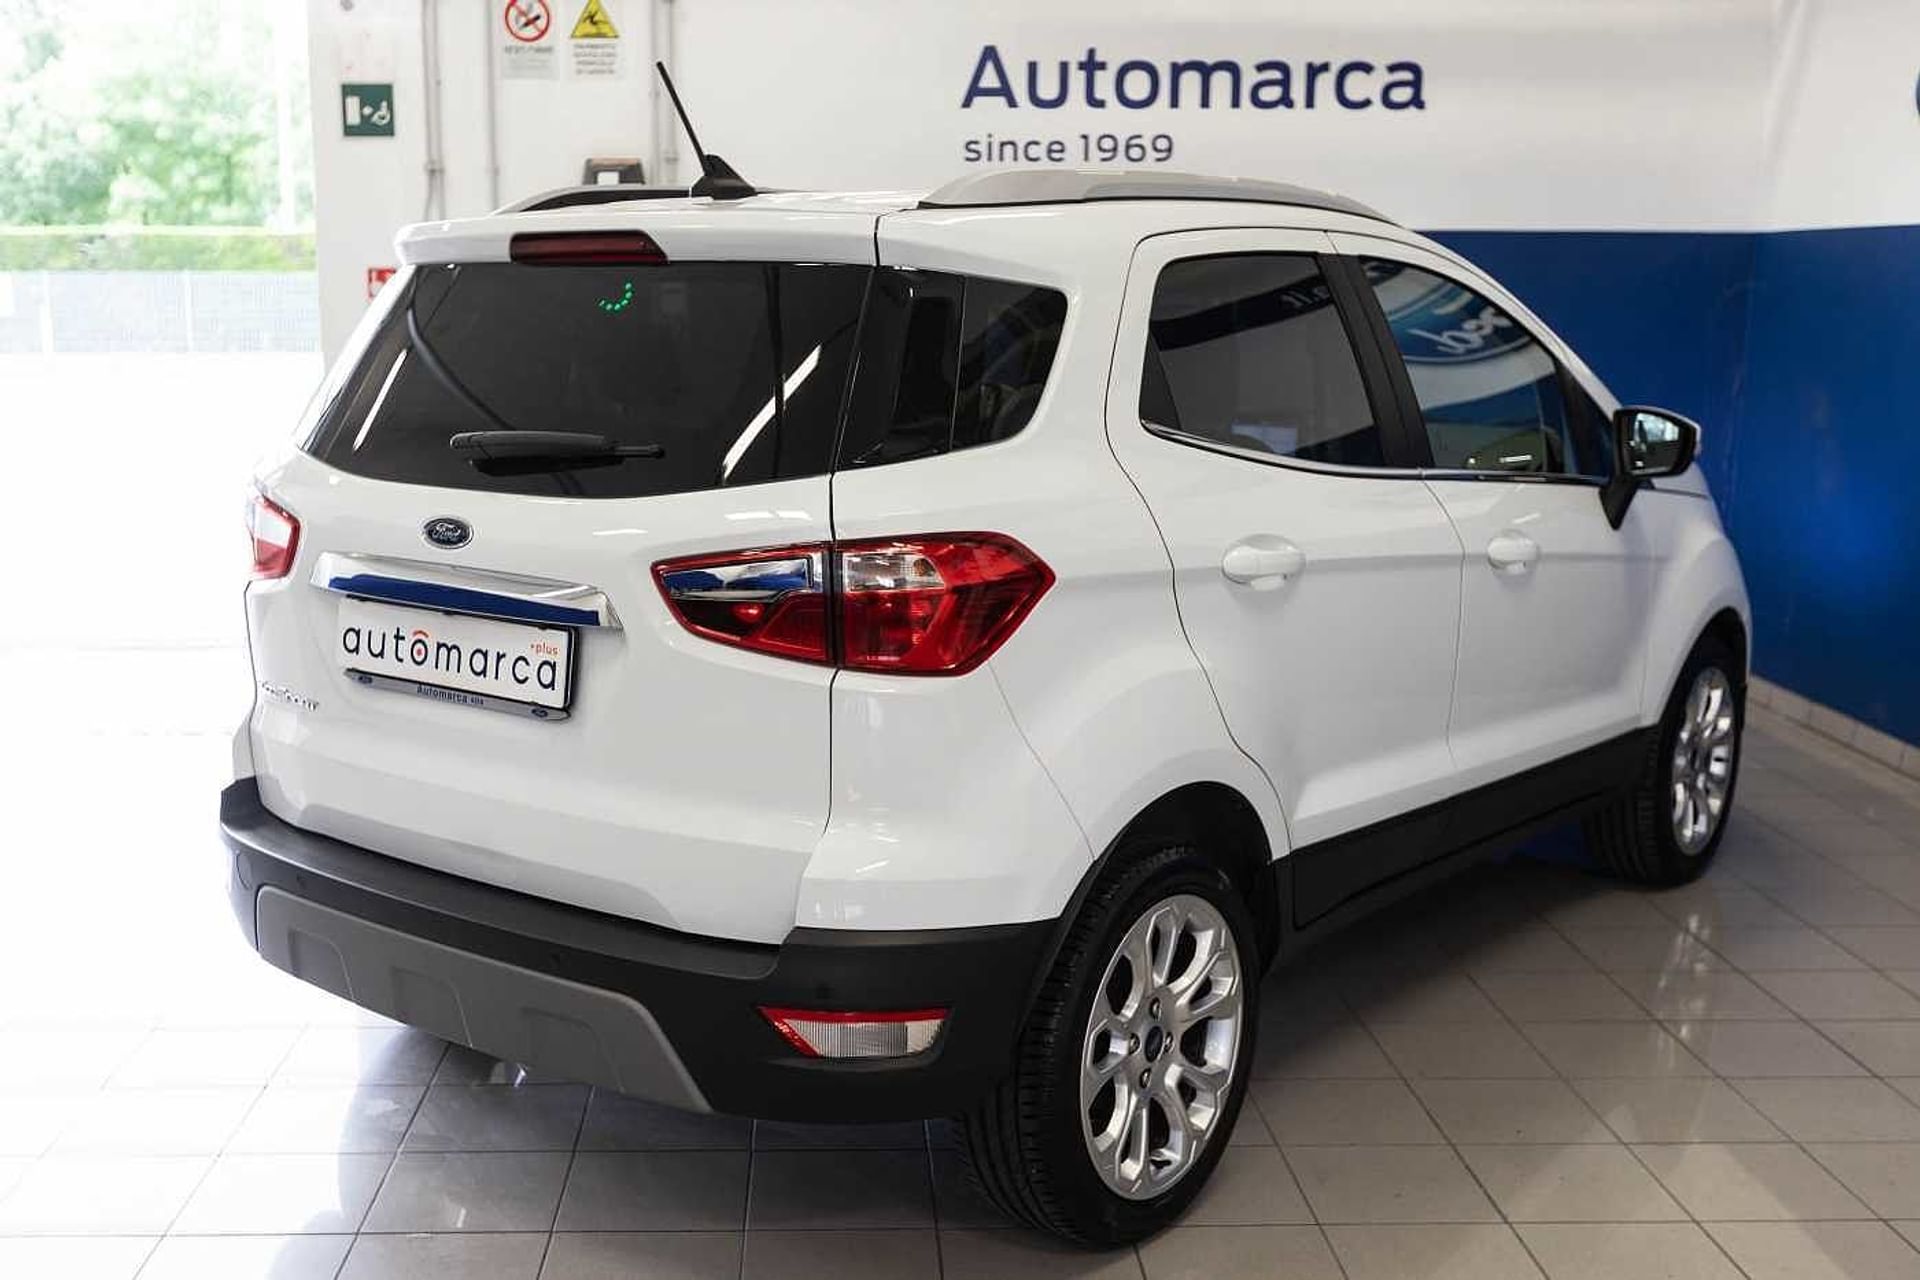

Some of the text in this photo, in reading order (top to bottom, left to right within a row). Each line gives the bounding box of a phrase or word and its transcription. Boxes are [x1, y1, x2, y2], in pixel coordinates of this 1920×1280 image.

[961, 45, 1426, 110] Automarca
[964, 134, 1174, 162] since 1969
